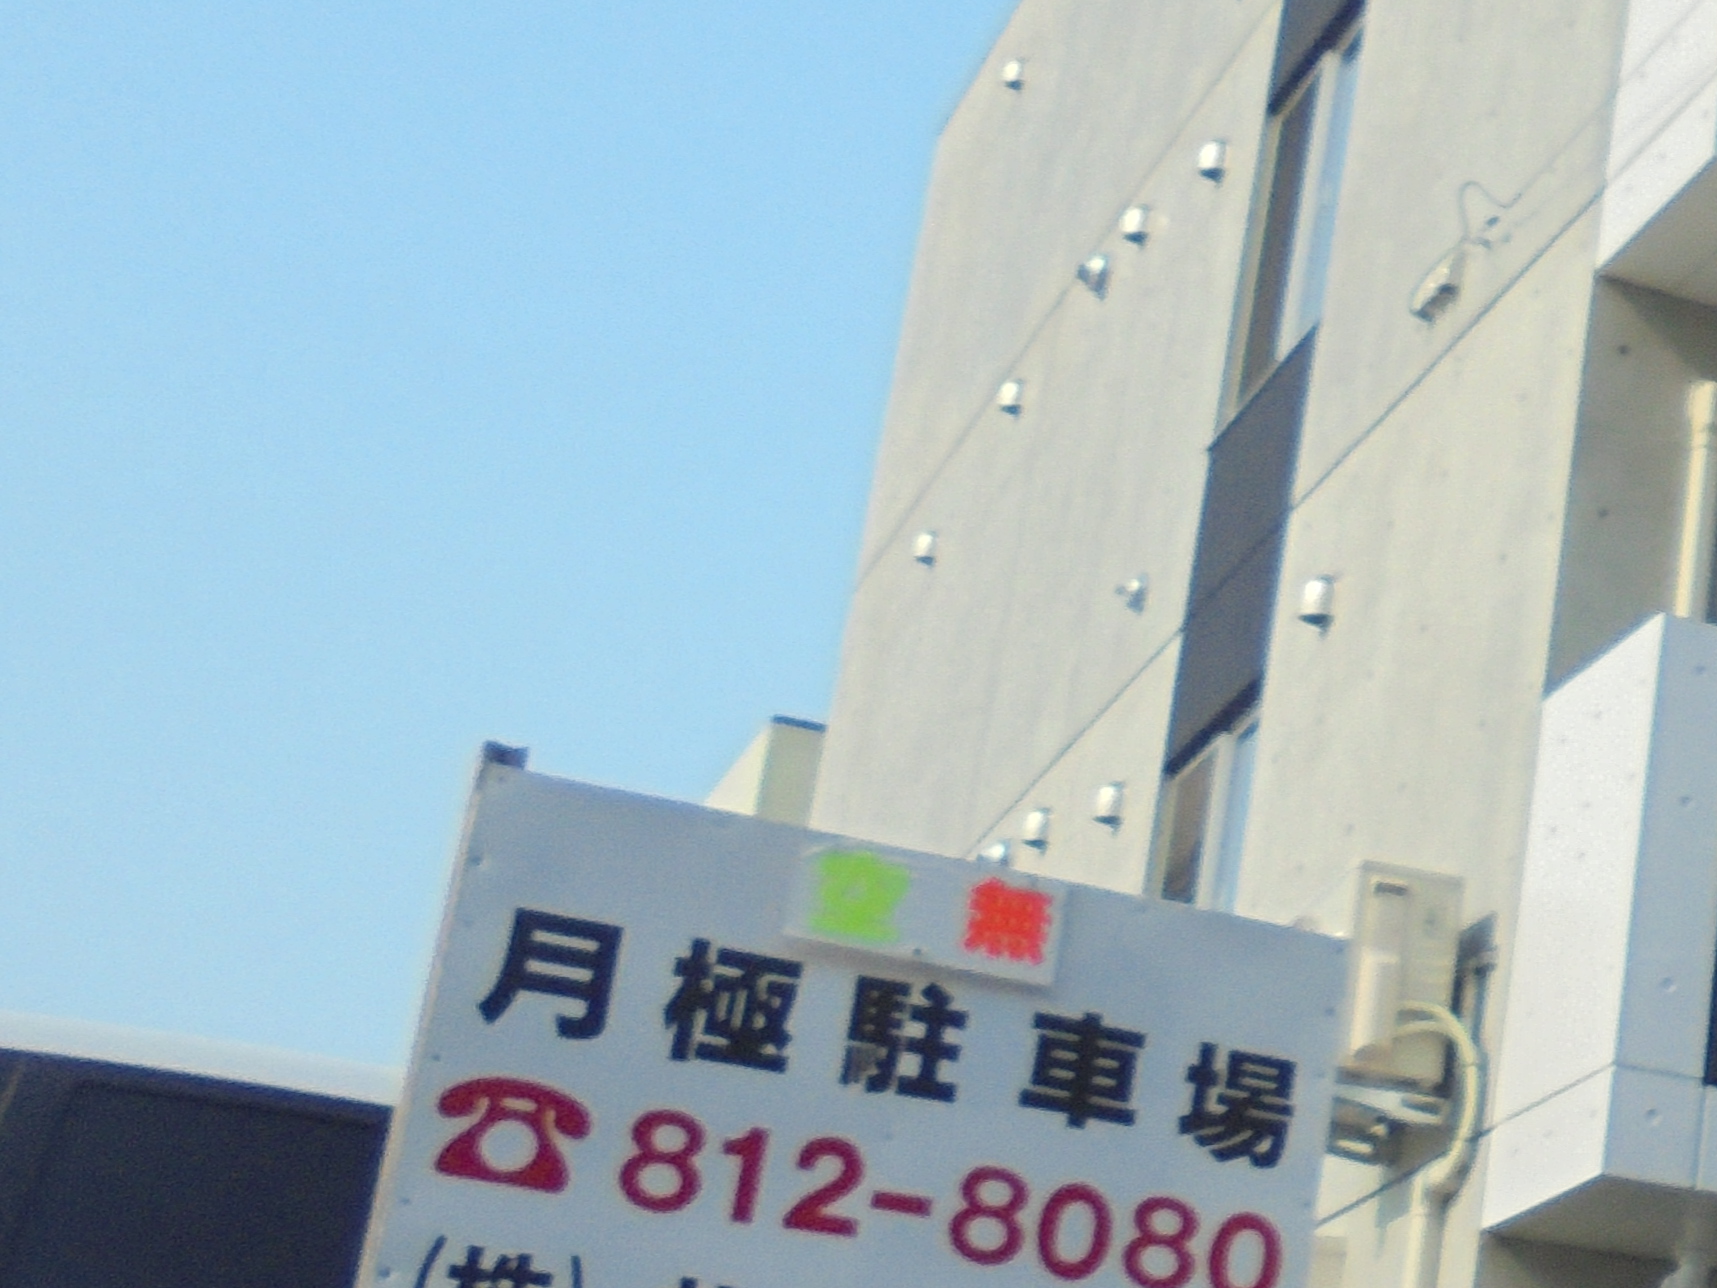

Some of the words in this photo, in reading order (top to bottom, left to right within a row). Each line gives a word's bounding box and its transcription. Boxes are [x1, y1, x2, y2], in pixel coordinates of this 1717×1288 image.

[478, 908, 1296, 1168] 月極駐車場
